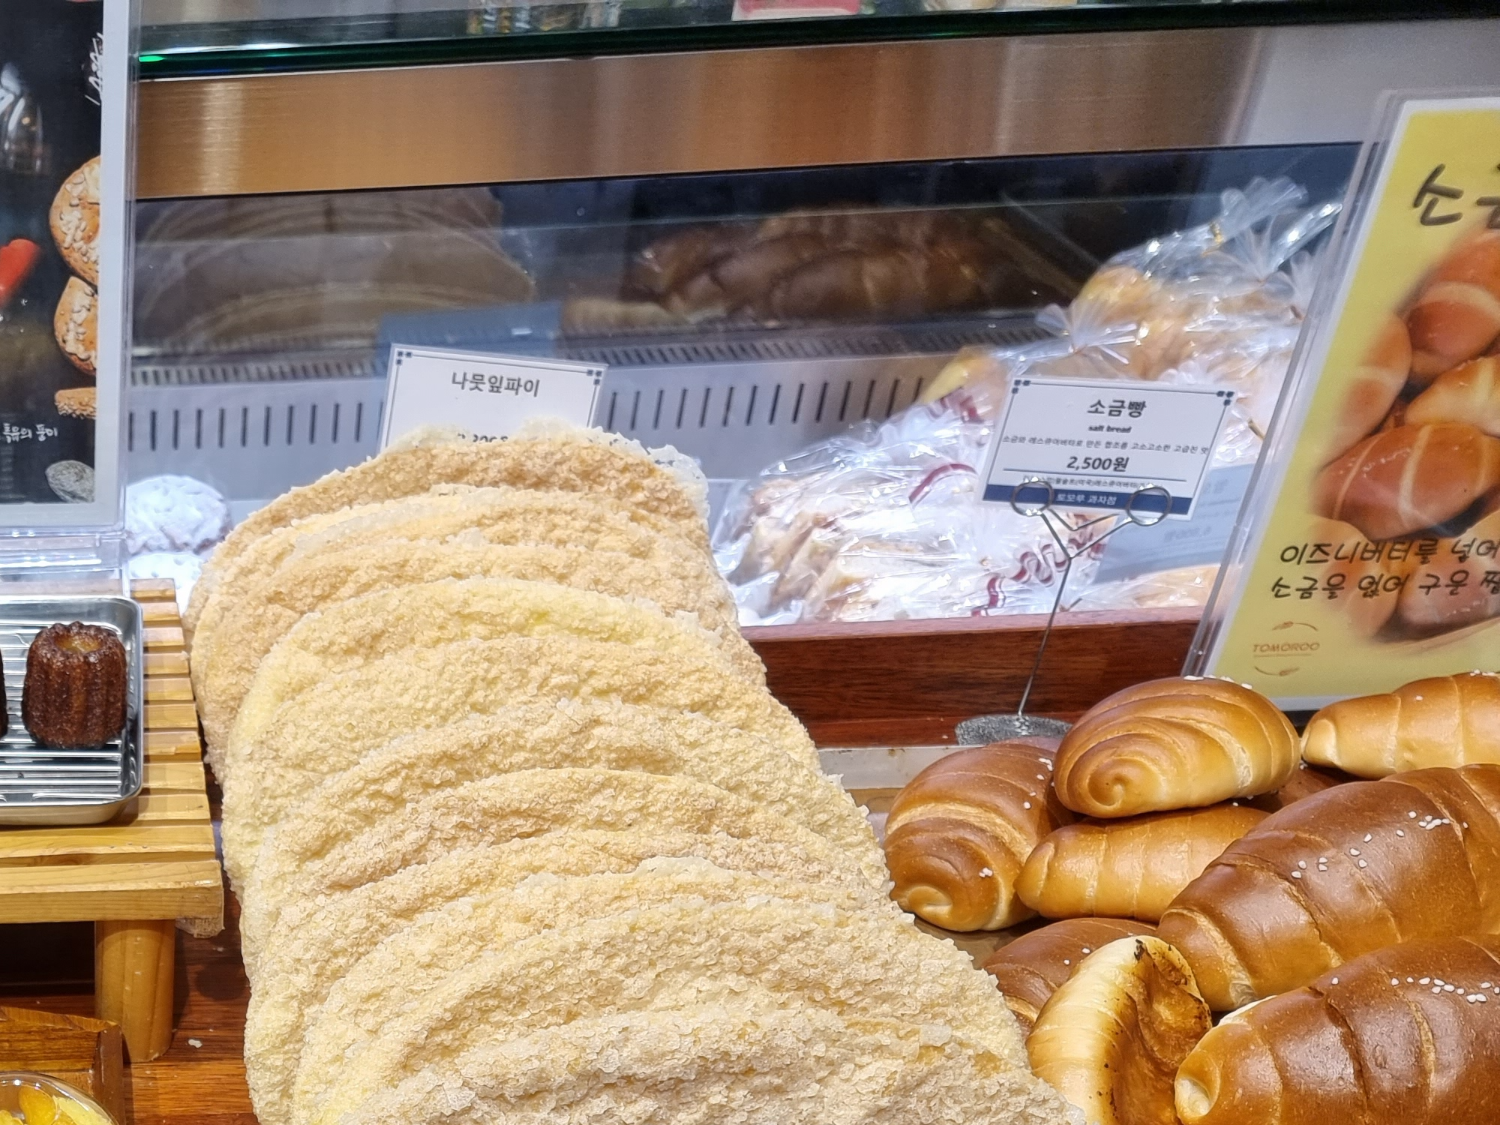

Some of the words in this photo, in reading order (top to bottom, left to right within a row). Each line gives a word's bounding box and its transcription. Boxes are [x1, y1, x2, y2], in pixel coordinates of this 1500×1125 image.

[451, 371, 541, 398] 나뭇잎파이
[1087, 398, 1147, 418] 소금빵
[1067, 455, 1129, 473] 2,500원
[1280, 538, 1440, 565] 이즈니버터를
[1271, 572, 1347, 600] 소금을
[1419, 569, 1470, 596] 구운
[1253, 641, 1320, 653] TOMOROO
